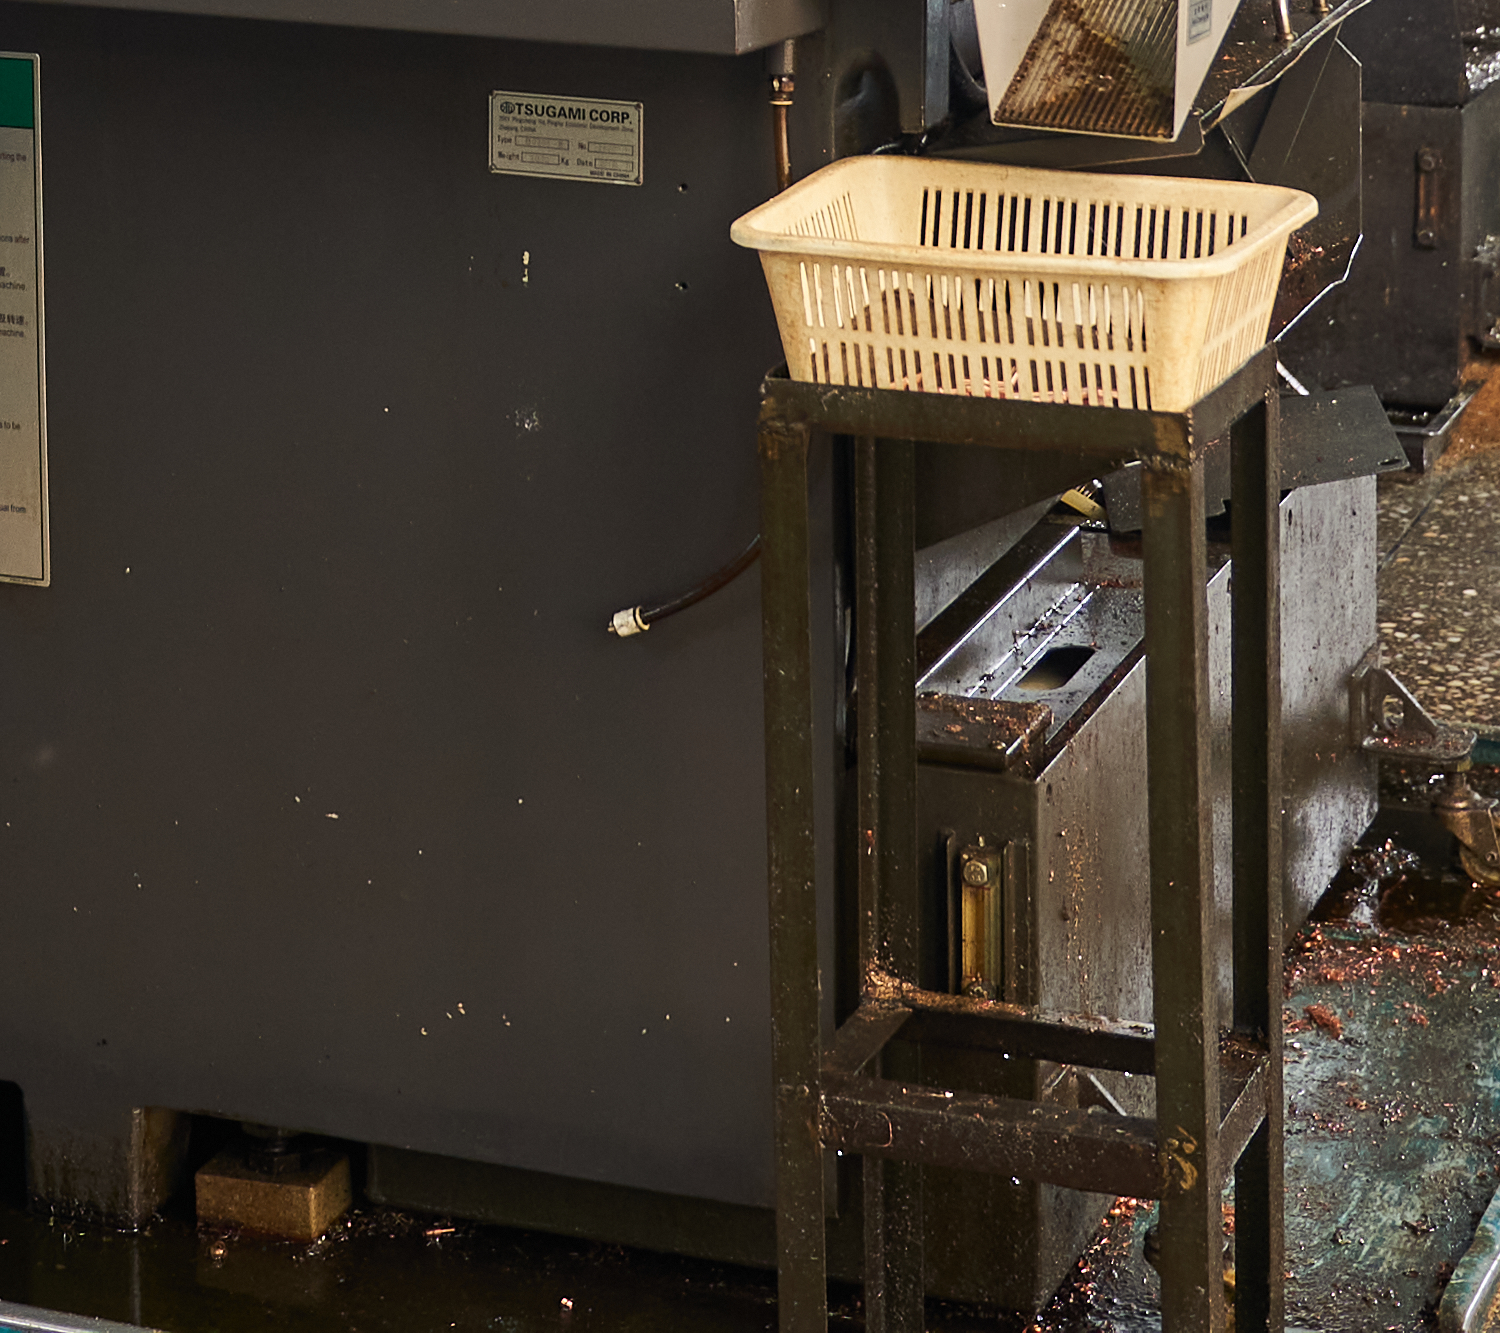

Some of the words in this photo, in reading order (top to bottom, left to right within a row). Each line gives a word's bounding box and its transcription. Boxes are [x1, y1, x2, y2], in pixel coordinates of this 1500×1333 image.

[515, 103, 586, 121] TSUGAMI
[589, 109, 632, 125] CORP.
[498, 135, 512, 144] Type
[561, 157, 570, 165] Kg
[576, 158, 592, 167] Date
[10, 505, 26, 515] from
